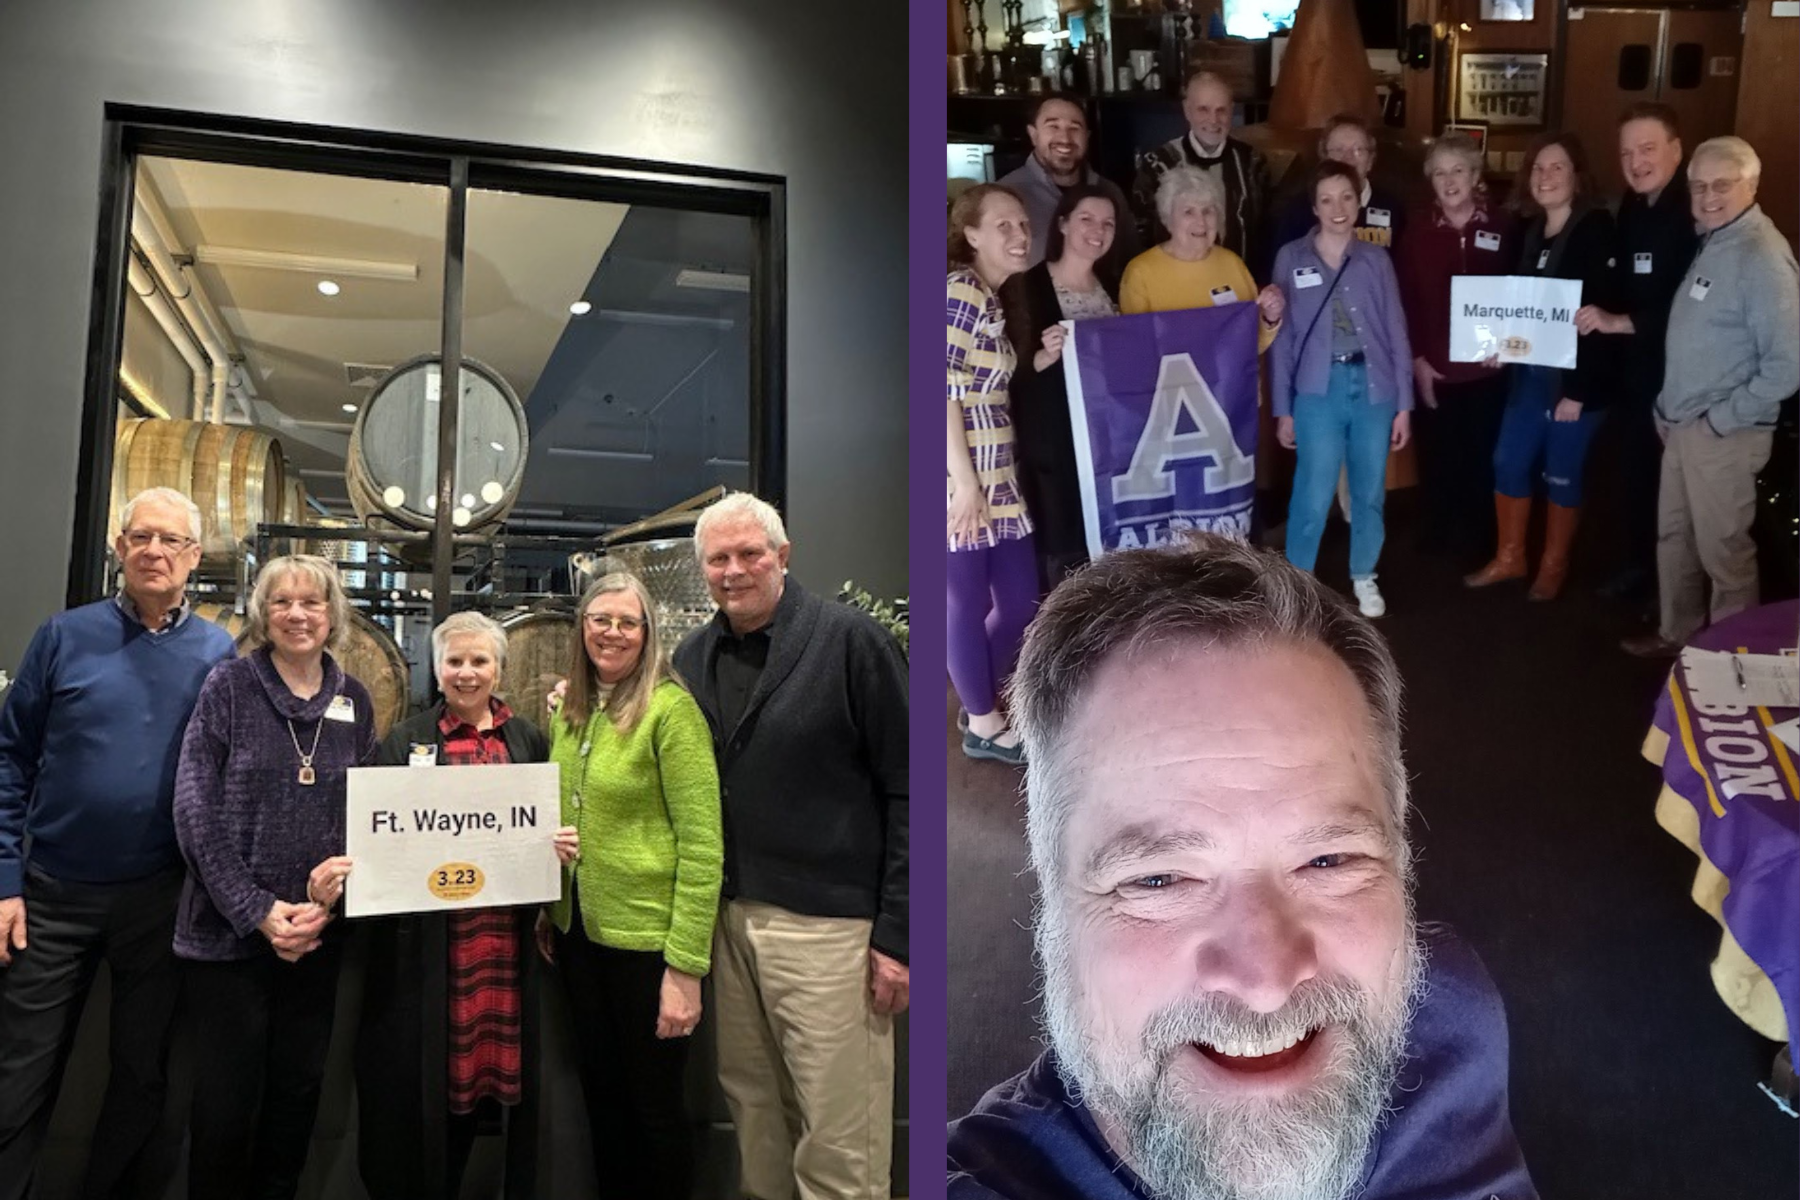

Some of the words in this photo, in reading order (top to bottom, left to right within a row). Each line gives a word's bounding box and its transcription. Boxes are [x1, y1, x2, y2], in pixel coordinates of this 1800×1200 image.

[1463, 303, 1547, 323] Marquette,
[1551, 307, 1570, 322] MI
[1111, 352, 1255, 505] A
[372, 811, 404, 834] Ft.
[414, 809, 503, 836] Wayne,
[511, 806, 537, 828] IN
[438, 869, 475, 886] 3.23
